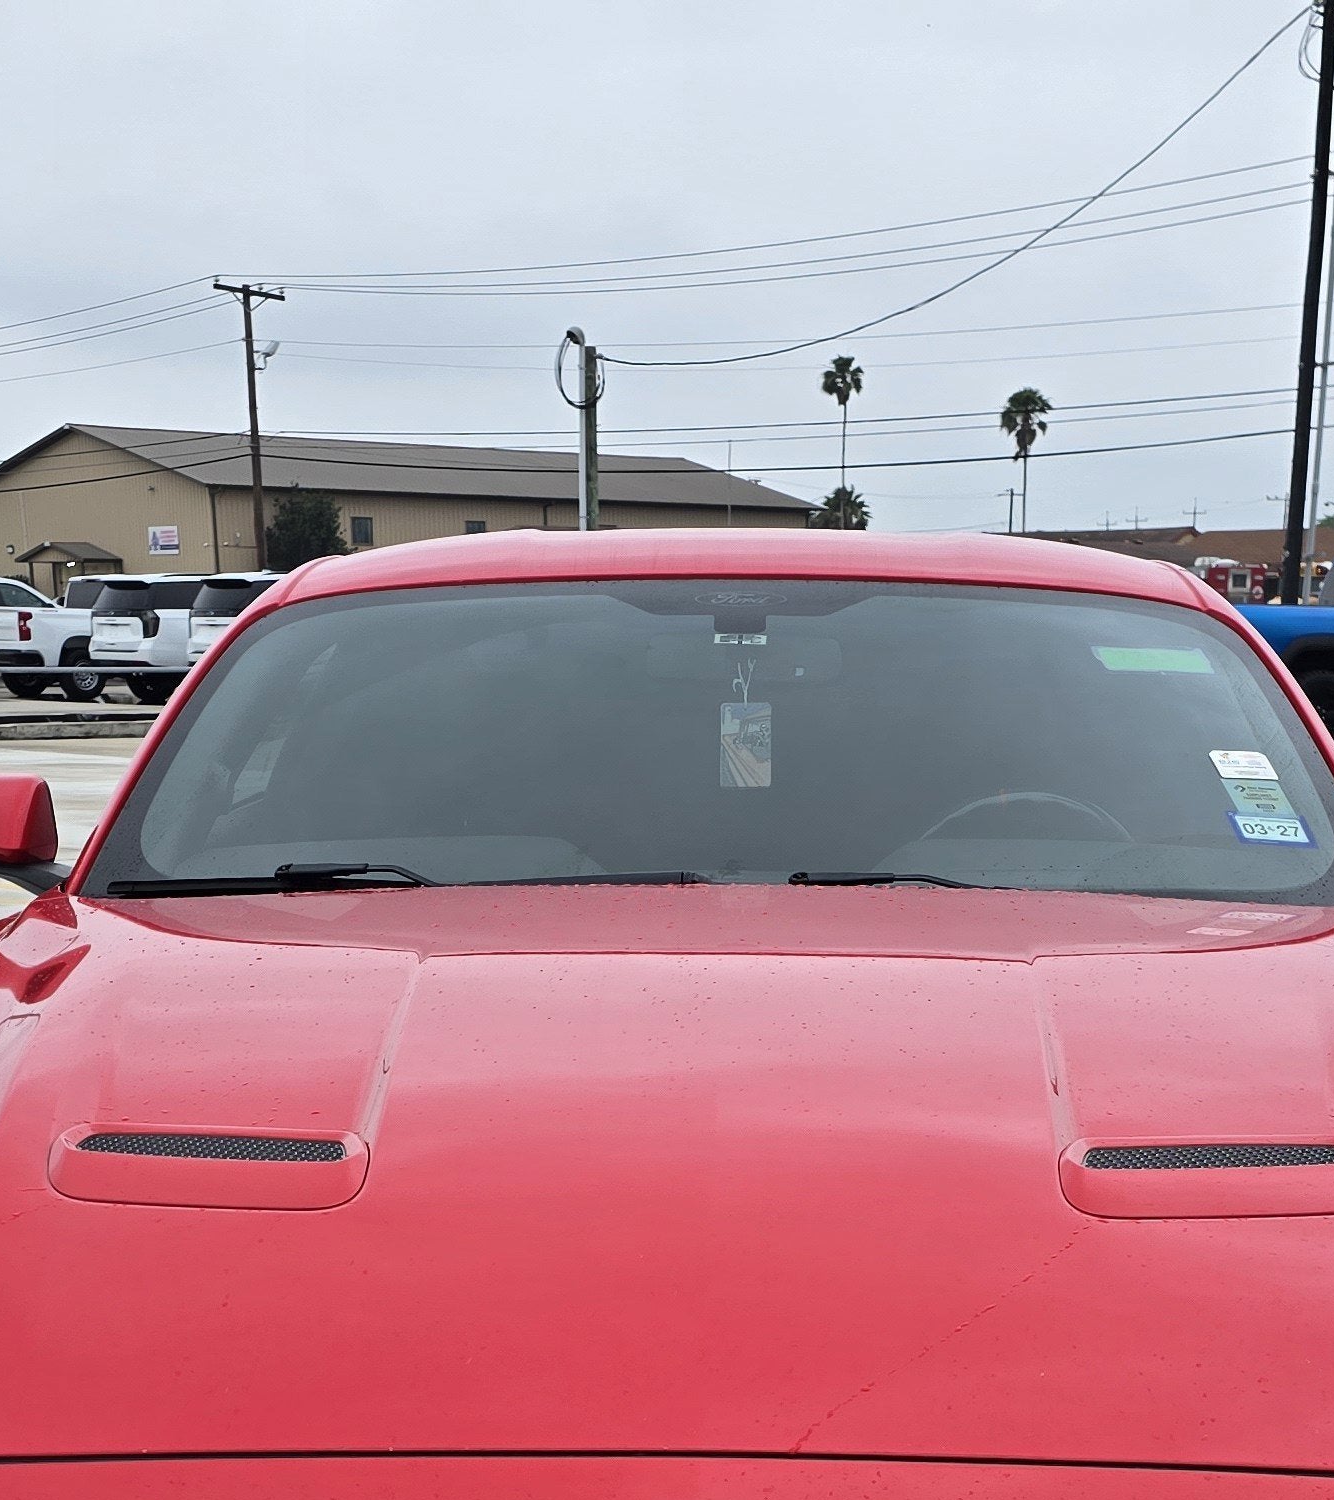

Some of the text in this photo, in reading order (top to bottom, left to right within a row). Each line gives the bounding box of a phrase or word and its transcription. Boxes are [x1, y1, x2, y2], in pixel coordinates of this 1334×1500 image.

[711, 591, 770, 604] Ford
[1243, 823, 1299, 837] 03 27
